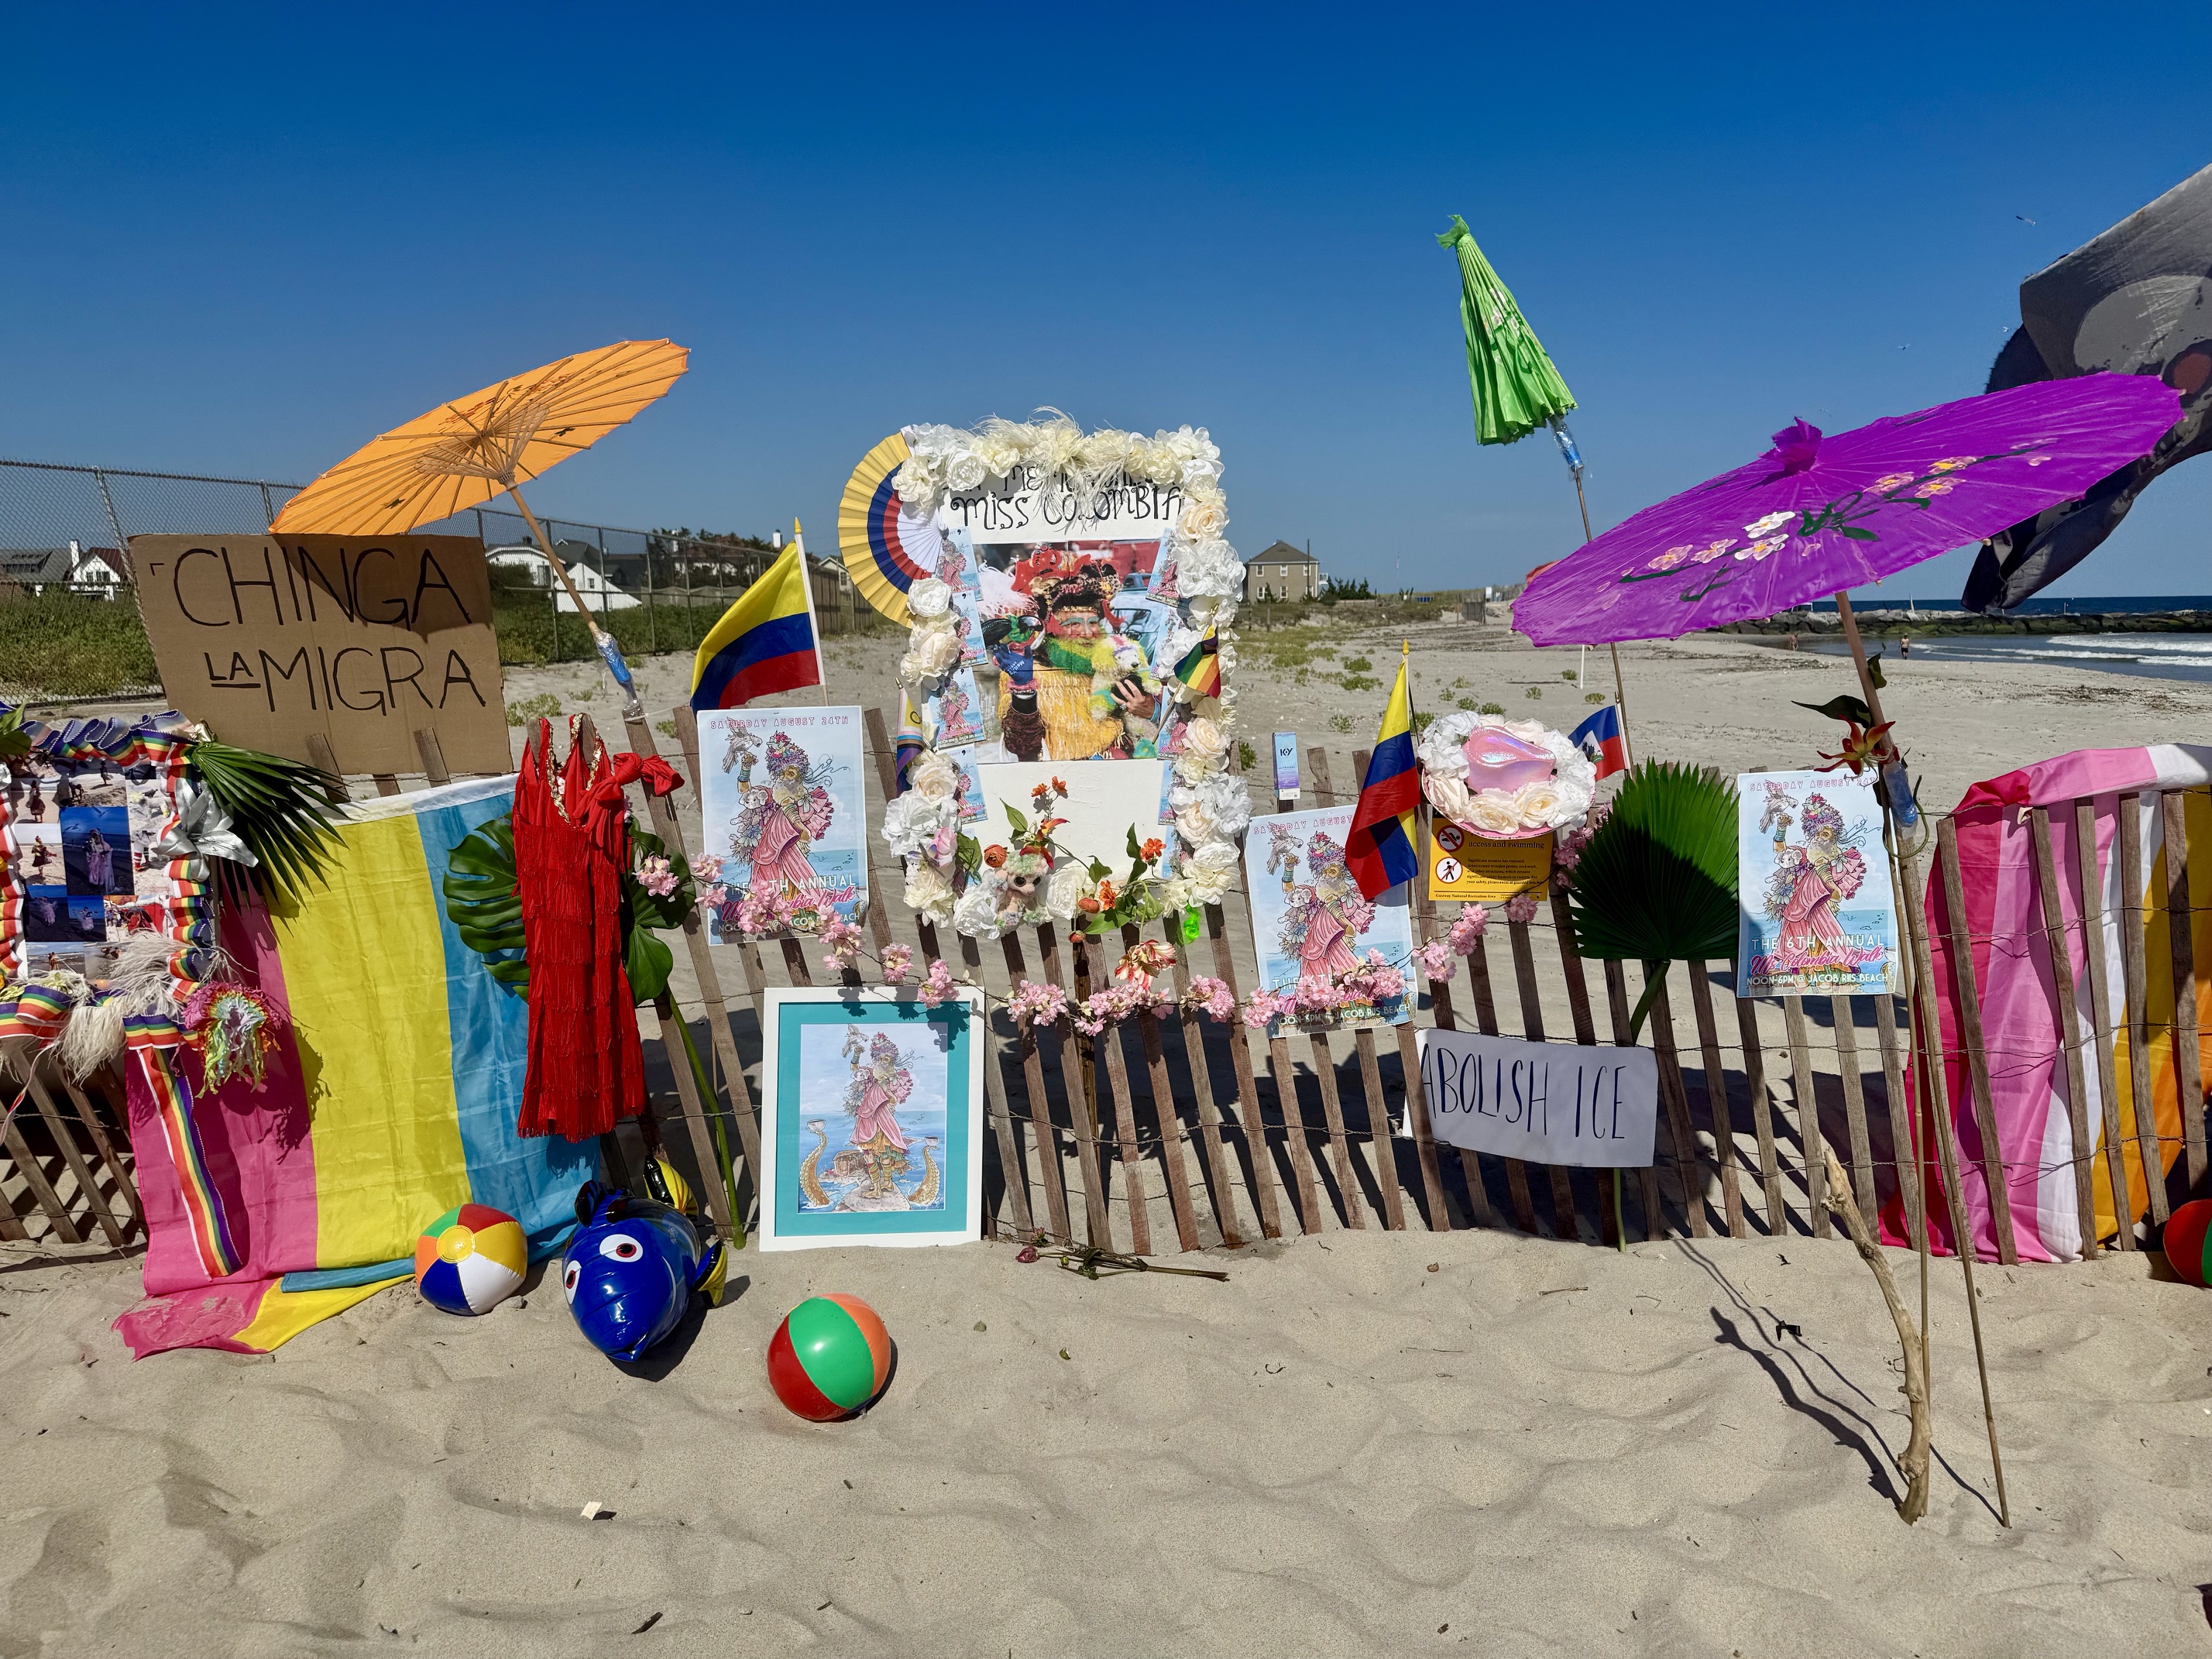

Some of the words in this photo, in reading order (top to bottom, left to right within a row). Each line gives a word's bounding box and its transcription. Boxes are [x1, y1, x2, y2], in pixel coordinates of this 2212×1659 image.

[1042, 485, 1183, 525] COOMBIA
[173, 546, 472, 631] CHINGA
[204, 651, 254, 682] LA
[258, 646, 486, 716] MIGRA
[710, 718, 768, 730] SATURDAY
[773, 716, 815, 727] AUGUST
[821, 716, 849, 726] 24TH
[1750, 780, 1804, 792] SATURDAY
[1809, 778, 1851, 789] AUGUST
[1253, 820, 1307, 835] SATURDAY
[1314, 815, 1353, 828] AUGUST
[1507, 841, 1545, 850] swimming
[768, 878, 789, 891] TH
[798, 873, 857, 890] ANNUAL
[817, 885, 857, 908] Walk
[1751, 937, 1778, 951] THE
[1786, 936, 1815, 950] 6TH
[1826, 933, 1884, 948] ANNUAL
[1781, 950, 1840, 972] Colombia
[1843, 946, 1884, 967] Walk
[1747, 973, 1794, 986] NOON-6PM
[1808, 974, 1839, 984] JACOB
[1842, 974, 1856, 983] RIIS
[1859, 973, 1888, 983] BEACH
[1334, 1008, 1365, 1021] JACOB
[1383, 1004, 1411, 1015] BEACH
[1420, 1042, 1548, 1136] ABOLISH
[1575, 1064, 1626, 1140] ICE
